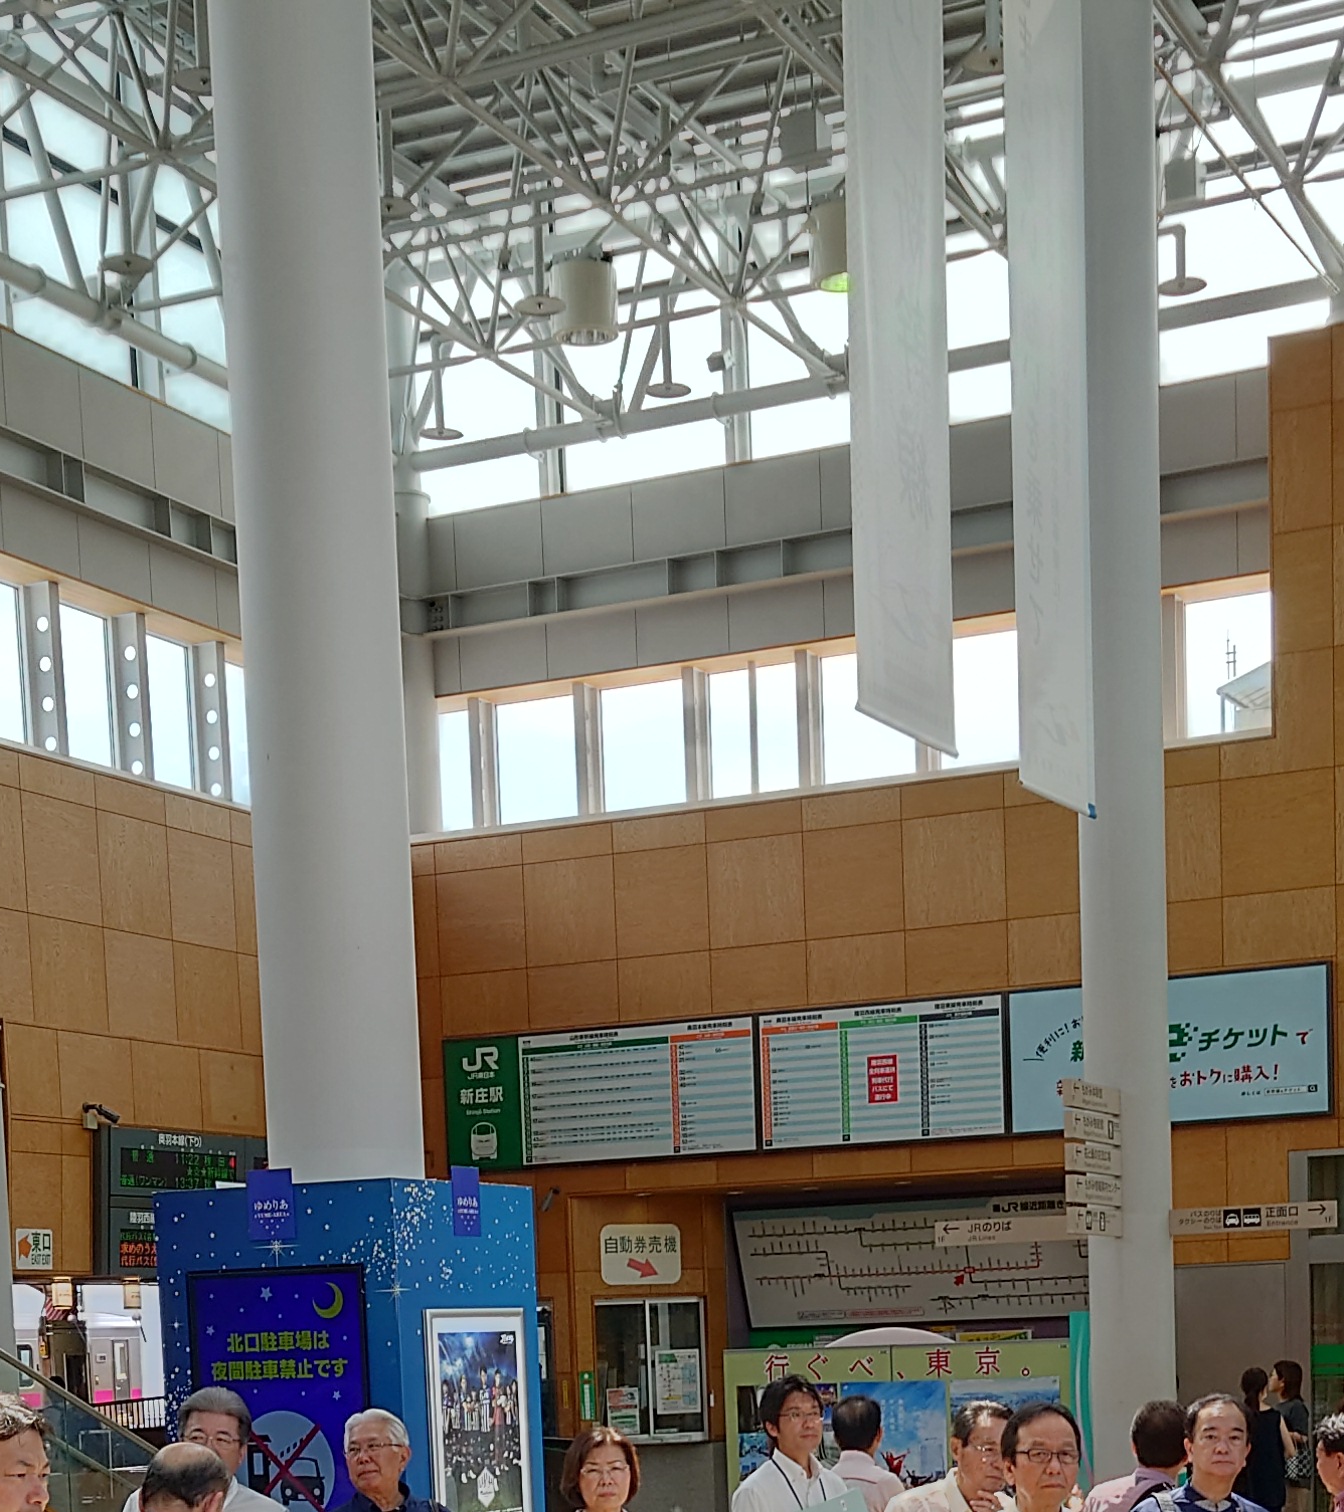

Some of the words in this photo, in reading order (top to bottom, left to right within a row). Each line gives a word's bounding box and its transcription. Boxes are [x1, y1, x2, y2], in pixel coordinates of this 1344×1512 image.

[462, 1046, 499, 1072] JR
[460, 1086, 504, 1105] 新庄駅
[175, 1153, 200, 1165] 11:22
[254, 1199, 289, 1211] ゆめりあ
[1265, 1206, 1298, 1218] 正面口
[967, 1221, 1012, 1233] JRのりば
[31, 1231, 51, 1252] 東口
[603, 1233, 678, 1256] 自動券売機
[226, 1330, 330, 1354] 北口駐車場は
[211, 1357, 349, 1382] 夜間駐車禁止です
